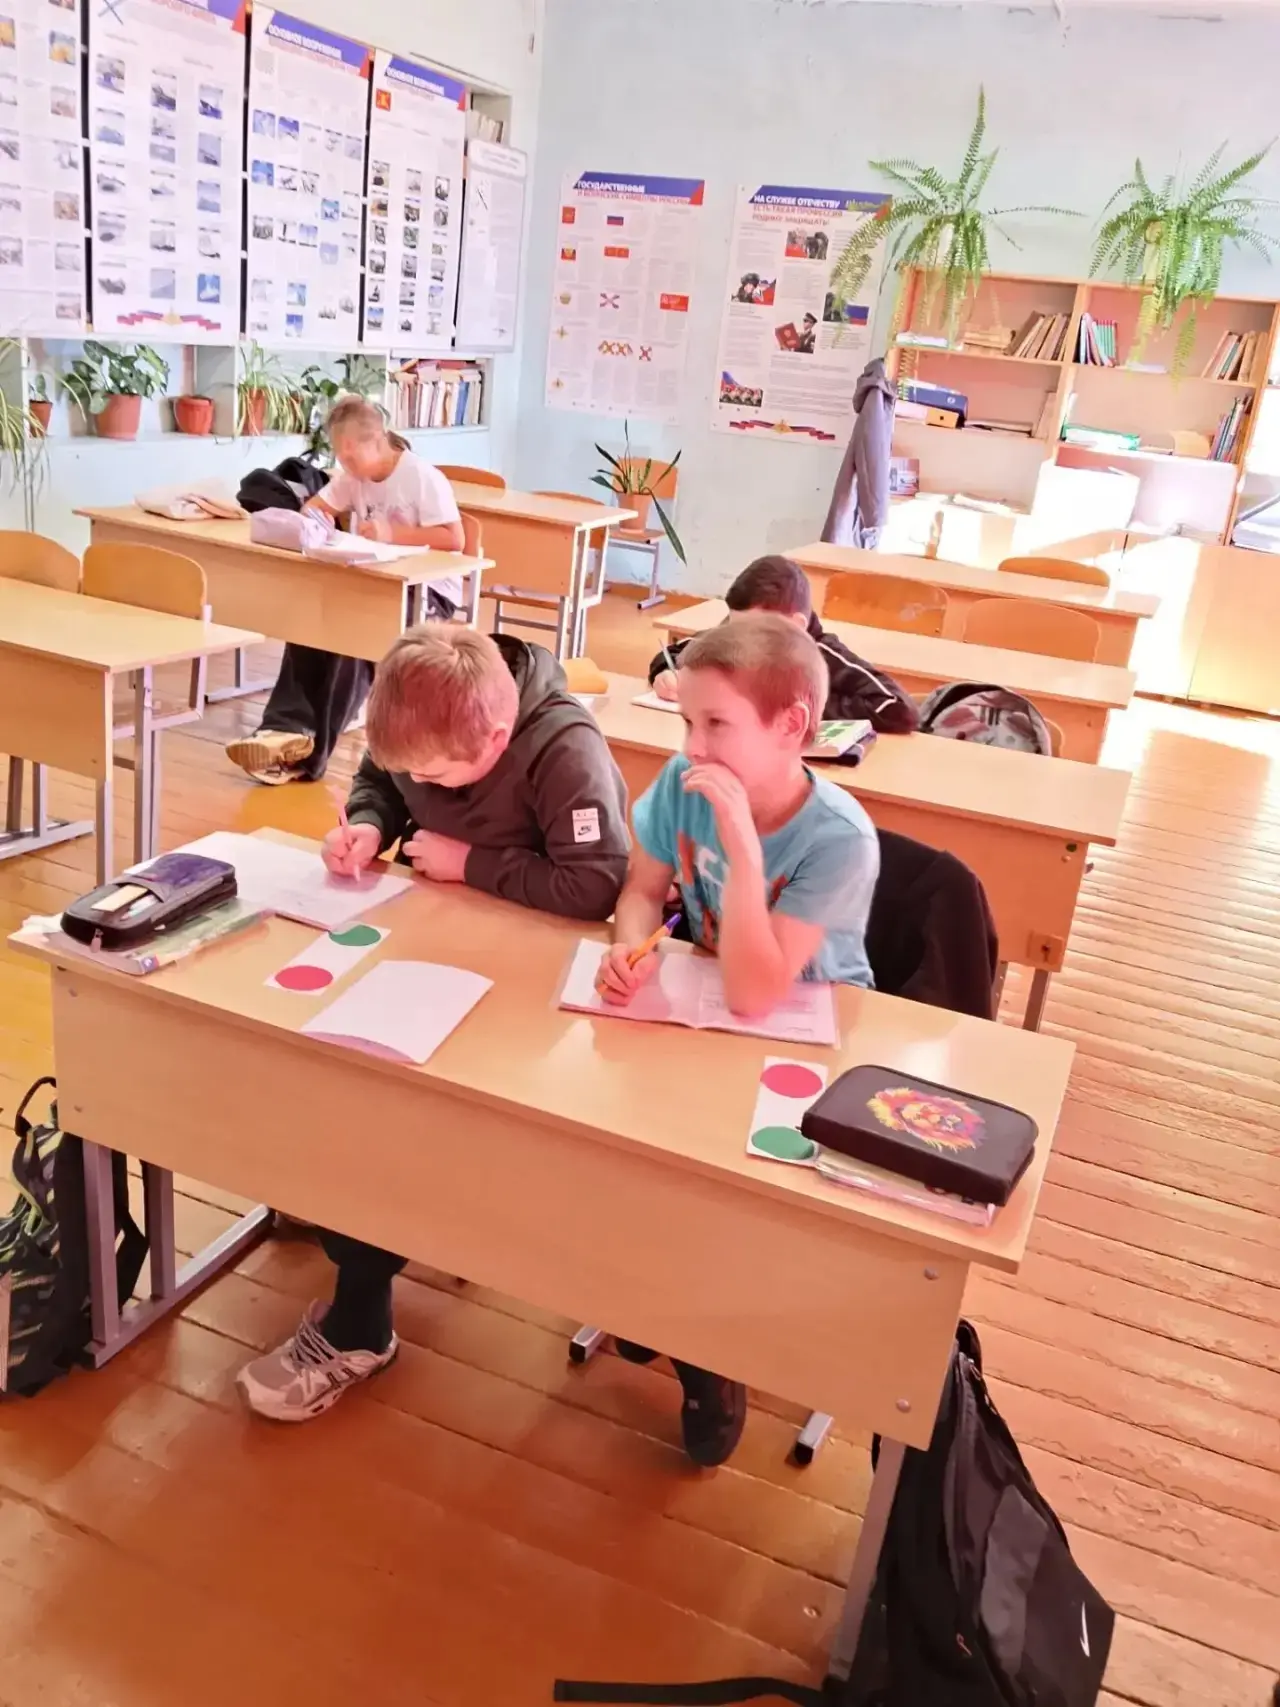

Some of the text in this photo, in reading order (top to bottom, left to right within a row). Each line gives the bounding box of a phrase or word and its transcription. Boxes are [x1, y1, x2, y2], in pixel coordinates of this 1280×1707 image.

[754, 195, 841, 209] НА СЛУЖБЕ ОТЕЧЕСТВУ
